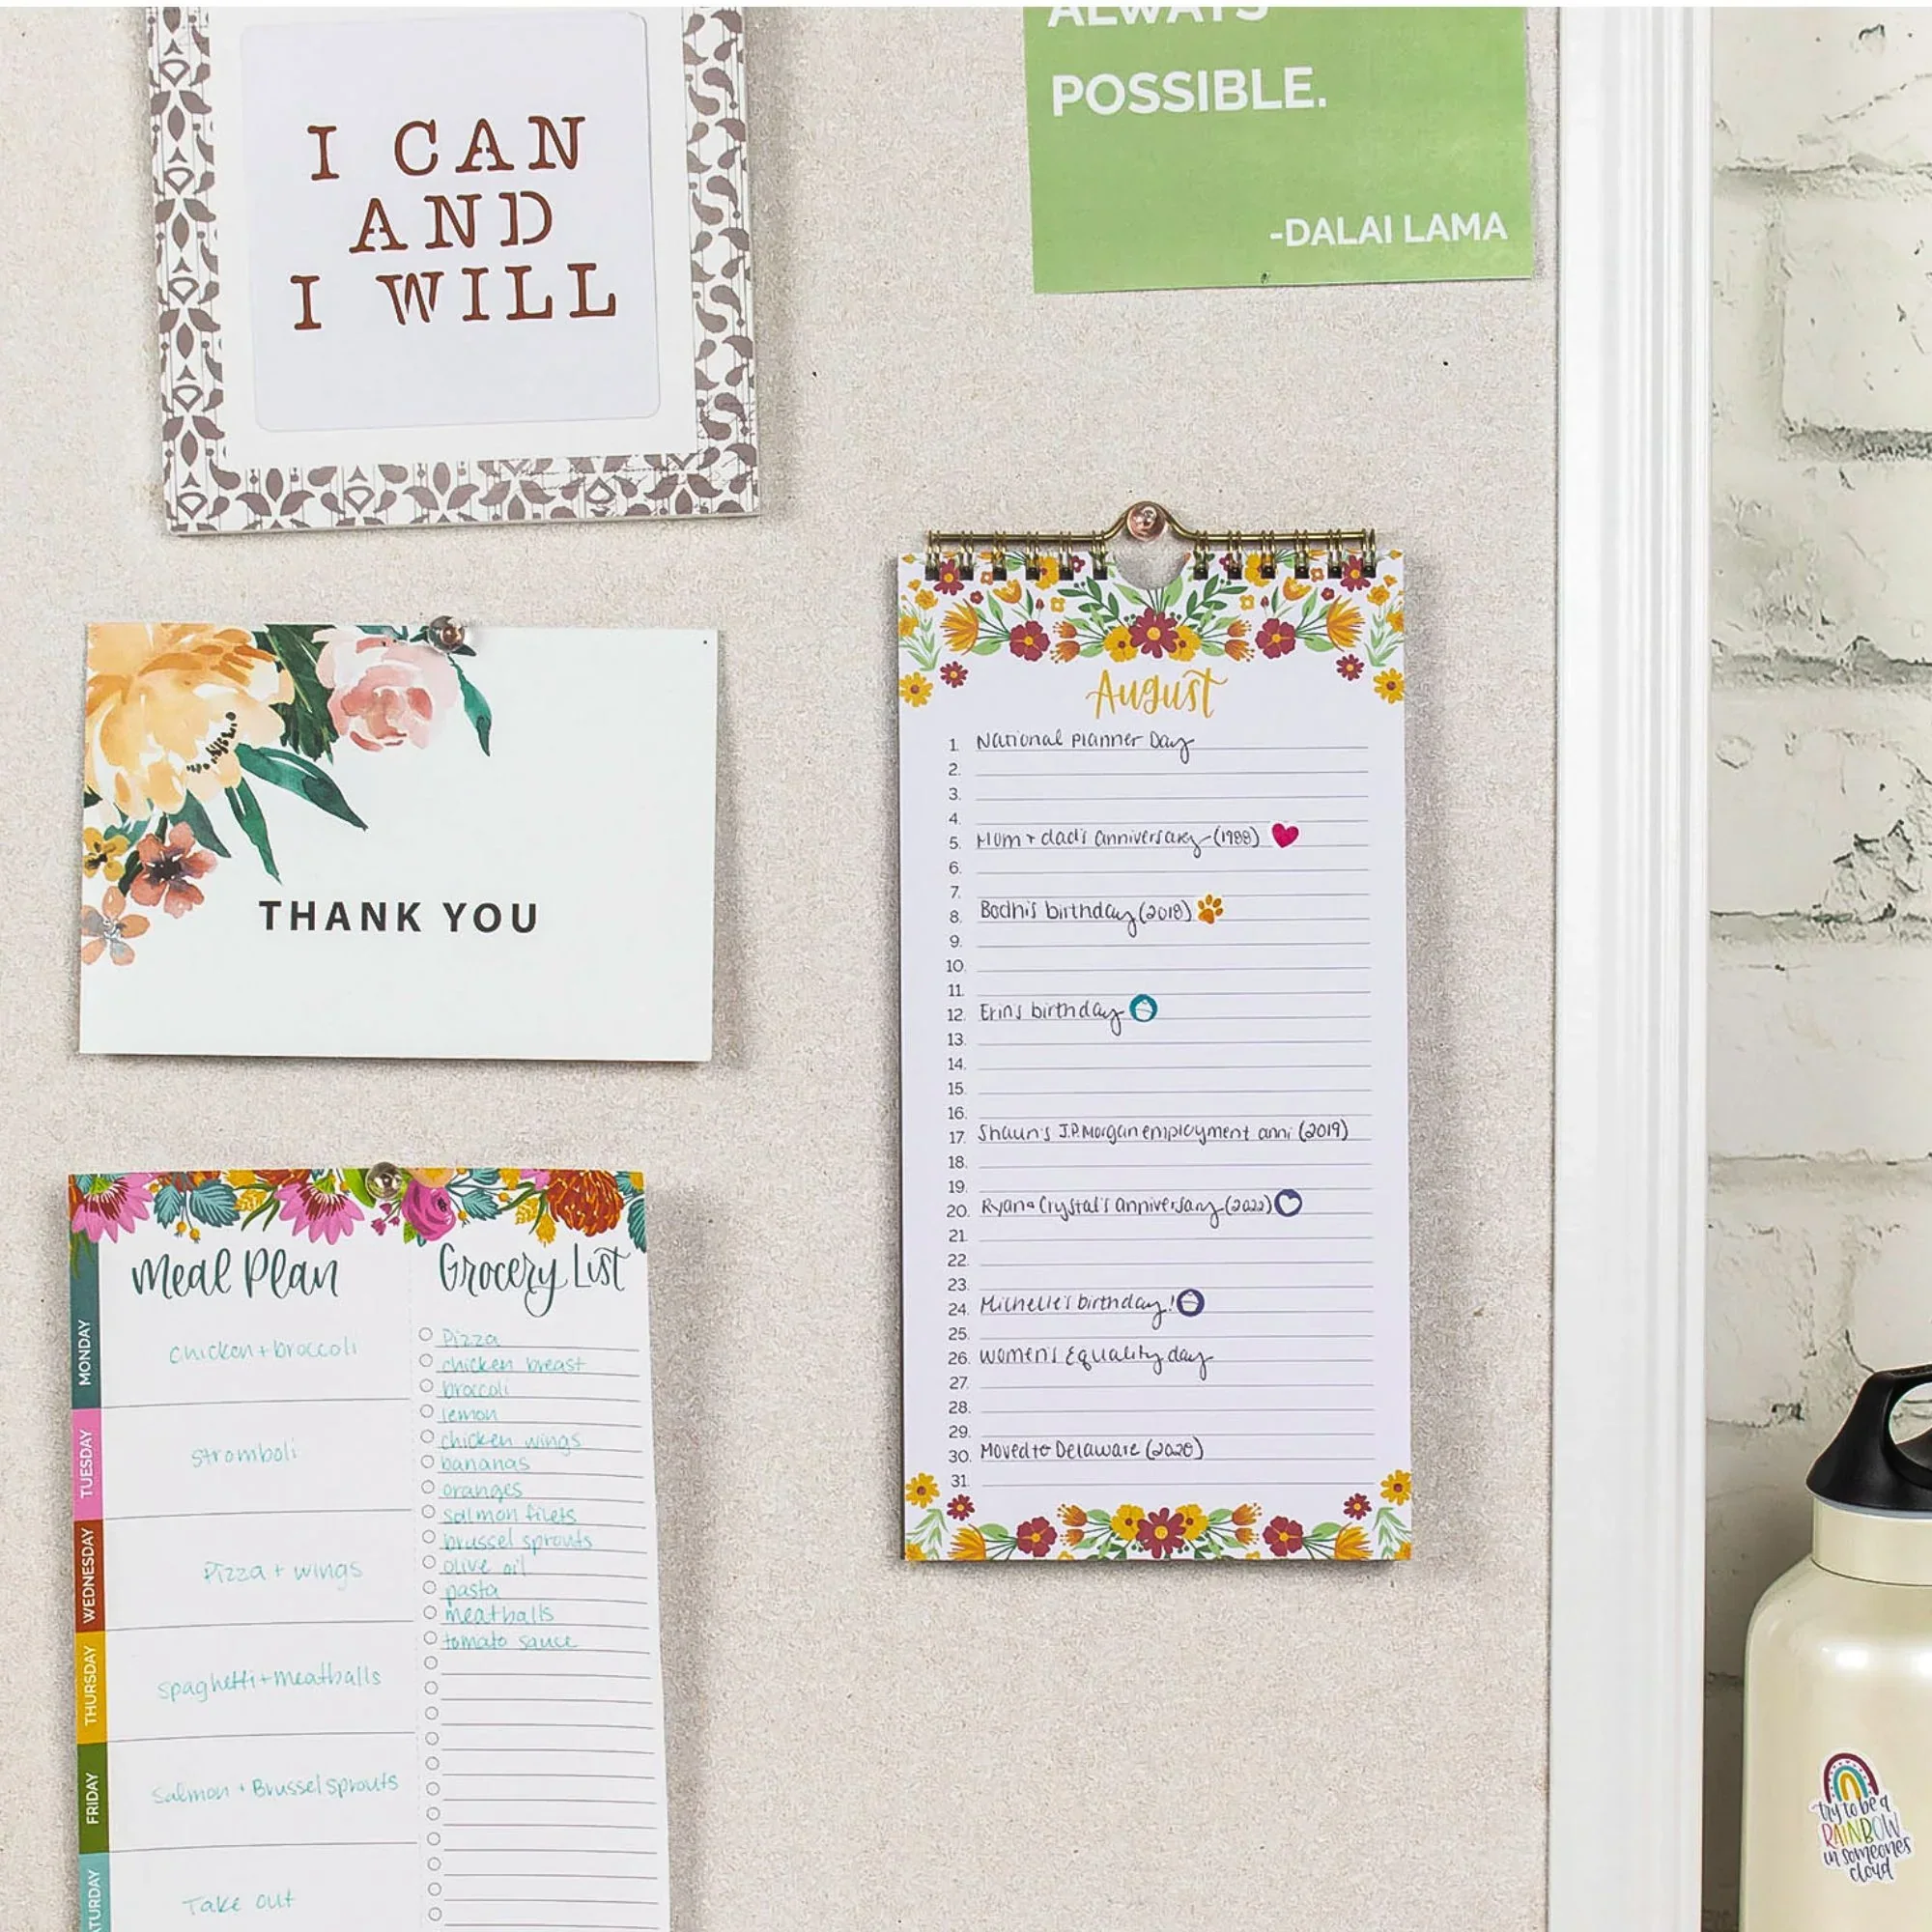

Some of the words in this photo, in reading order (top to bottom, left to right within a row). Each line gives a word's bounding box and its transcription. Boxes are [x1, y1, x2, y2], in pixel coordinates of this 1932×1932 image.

[1051, 66, 1327, 117] POSSIBLE.
[307, 125, 339, 181] I
[394, 115, 585, 176] CAN
[349, 190, 553, 253] AND
[1269, 214, 1393, 247] -DALAI
[1404, 212, 1508, 243] LAMA
[290, 274, 322, 330] I
[376, 263, 616, 326] WILL
[1086, 667, 1228, 719] August
[977, 729, 1063, 750] National
[1150, 730, 1195, 764] Day
[948, 761, 961, 777] 2.
[949, 786, 962, 801] 3.
[948, 811, 961, 825] 4.
[949, 836, 962, 850] 5.
[949, 860, 962, 875] 6.
[950, 885, 961, 899] 7.
[258, 900, 422, 932] THANK
[442, 902, 539, 934] YOU
[949, 909, 963, 924] 8.
[1045, 899, 1137, 938] birthday
[1139, 899, 1192, 924] (2018)
[949, 934, 963, 949] 9.
[946, 958, 967, 974] 10.
[947, 1008, 966, 1022] 12.
[1031, 999, 1125, 1037] birthday
[947, 1032, 967, 1047] 13.
[948, 1057, 967, 1071] 14.
[948, 1081, 964, 1096] 15.
[948, 1105, 968, 1121] 16.
[949, 1130, 966, 1145] 17.
[1298, 1120, 1350, 1142] (2019)
[948, 1154, 968, 1170] 18.
[948, 1179, 968, 1194] 19.
[946, 1204, 971, 1218] 20.
[981, 1197, 1025, 1217] Ryan
[947, 1253, 970, 1267] 22.
[243, 1247, 340, 1299] Plan
[440, 1241, 568, 1318] Grocery
[573, 1242, 633, 1292] List
[947, 1277, 970, 1292] 23.
[948, 1302, 970, 1317] 24.
[948, 1326, 971, 1342] 25.
[78, 1319, 93, 1387] MONDAY
[441, 1355, 514, 1372] chicken
[526, 1355, 587, 1372] breast
[948, 1350, 971, 1366] 26.
[1167, 1348, 1215, 1381] day
[441, 1378, 510, 1398] broccoli
[949, 1376, 969, 1390] 27.
[441, 1406, 499, 1421] lemon
[948, 1400, 972, 1415] 28.
[949, 1424, 972, 1439] 29.
[440, 1431, 513, 1449] chicken
[525, 1432, 582, 1457] wings
[980, 1441, 1030, 1460] Moved
[1056, 1439, 1141, 1459] Delaware
[1145, 1435, 1205, 1461] (2020)
[80, 1428, 95, 1499] TUESDAY
[440, 1456, 530, 1471] bananas
[948, 1449, 973, 1464] 30.
[442, 1481, 524, 1503] oranges
[443, 1506, 519, 1524] salmon
[525, 1503, 579, 1524] filets
[443, 1527, 514, 1550] brussel
[523, 1529, 593, 1556] sprouts
[82, 1526, 98, 1624] WEDNESDAY
[294, 1559, 363, 1591] wings
[442, 1556, 491, 1575] olive
[502, 1552, 526, 1577] oil
[445, 1578, 500, 1606] pasta
[445, 1603, 554, 1625] meatballs
[442, 1630, 508, 1650] tomato
[518, 1636, 580, 1650] sauce
[84, 1645, 97, 1727] THURSDAY
[156, 1669, 256, 1703] spaghetti
[273, 1661, 383, 1687] meatballs
[85, 1772, 99, 1825] FRIDAY
[1811, 1801, 1844, 1825] try
[1842, 1801, 1859, 1817] to
[1859, 1796, 1878, 1815] be
[1879, 1794, 1891, 1812] a
[1821, 1811, 1902, 1850] RAINBOW
[1823, 1850, 1840, 1867] in
[1841, 1836, 1913, 1864] someones
[1849, 1856, 1894, 1883] cloud
[88, 1869, 101, 1932] TURDAY
[182, 1895, 242, 1916] Take
[255, 1888, 296, 1908] out
